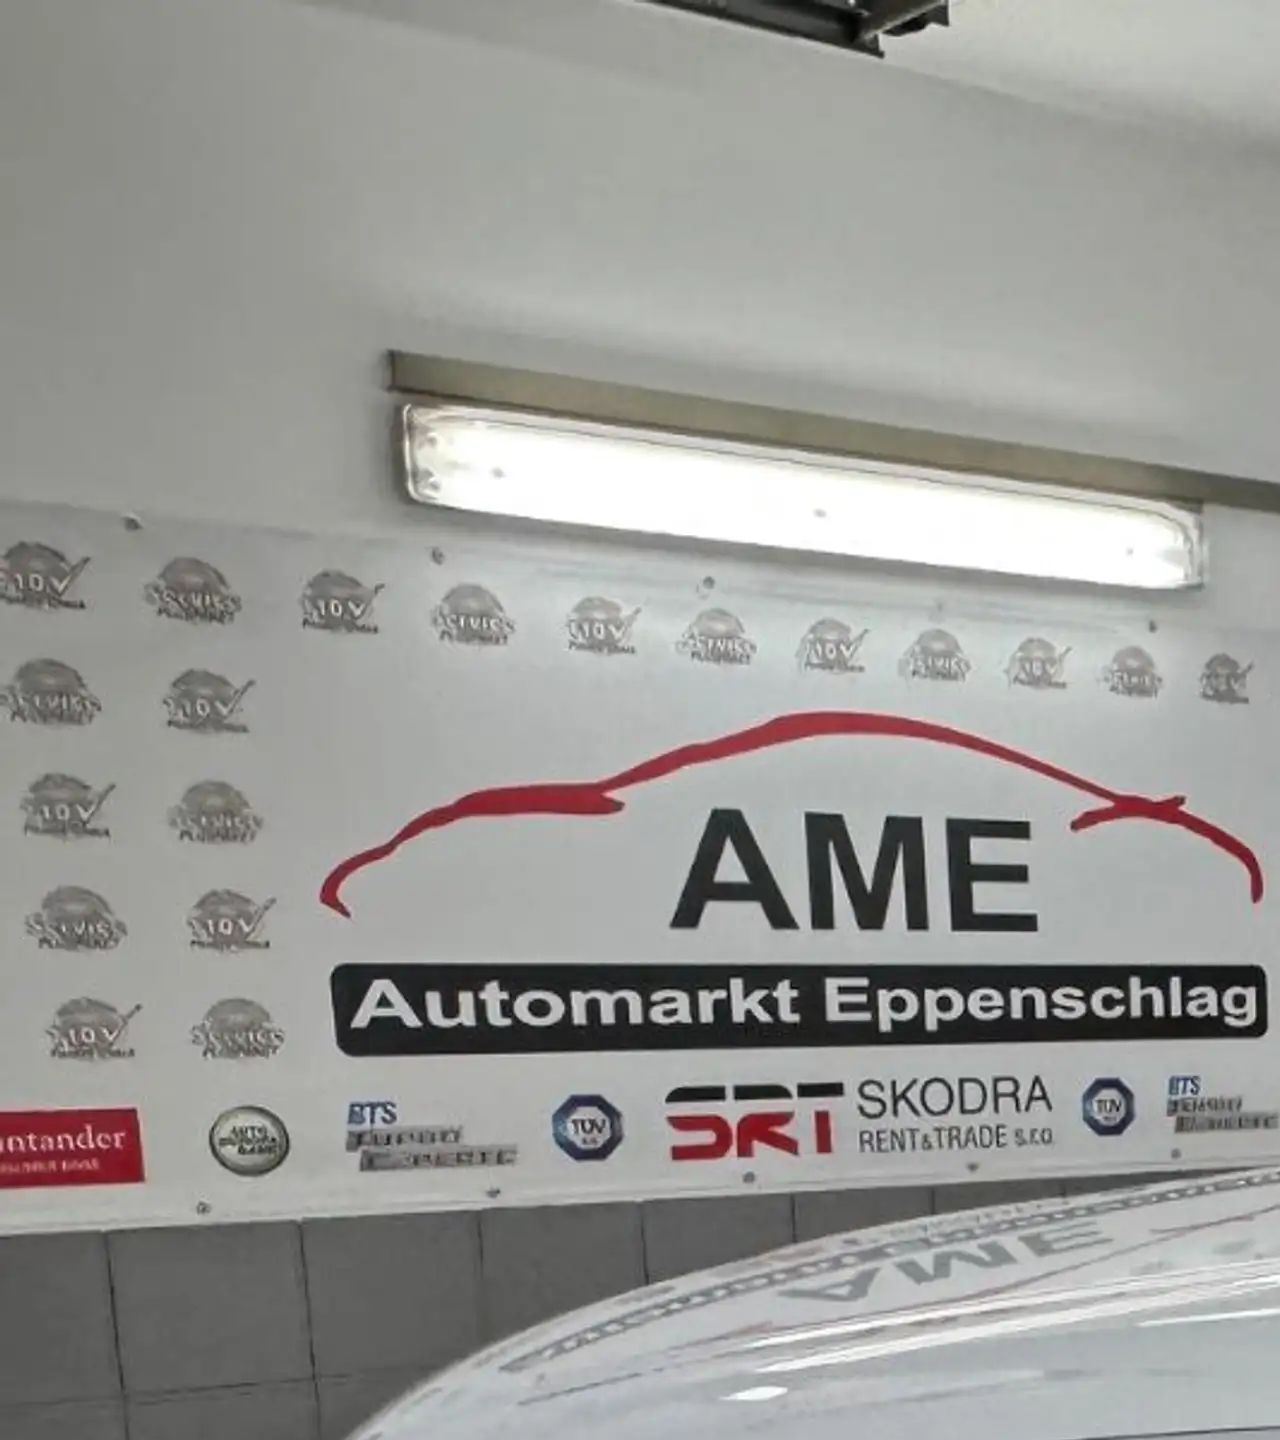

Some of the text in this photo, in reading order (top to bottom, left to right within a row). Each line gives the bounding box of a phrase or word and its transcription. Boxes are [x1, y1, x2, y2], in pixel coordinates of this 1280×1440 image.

[669, 808, 1038, 931] AME
[350, 975, 1257, 1033] Automarkt Eppenschlag
[347, 1101, 398, 1125] BTS
[665, 1081, 844, 1161] SRT
[857, 1075, 1053, 1119] SKODRA
[0, 1123, 126, 1153] ntander
